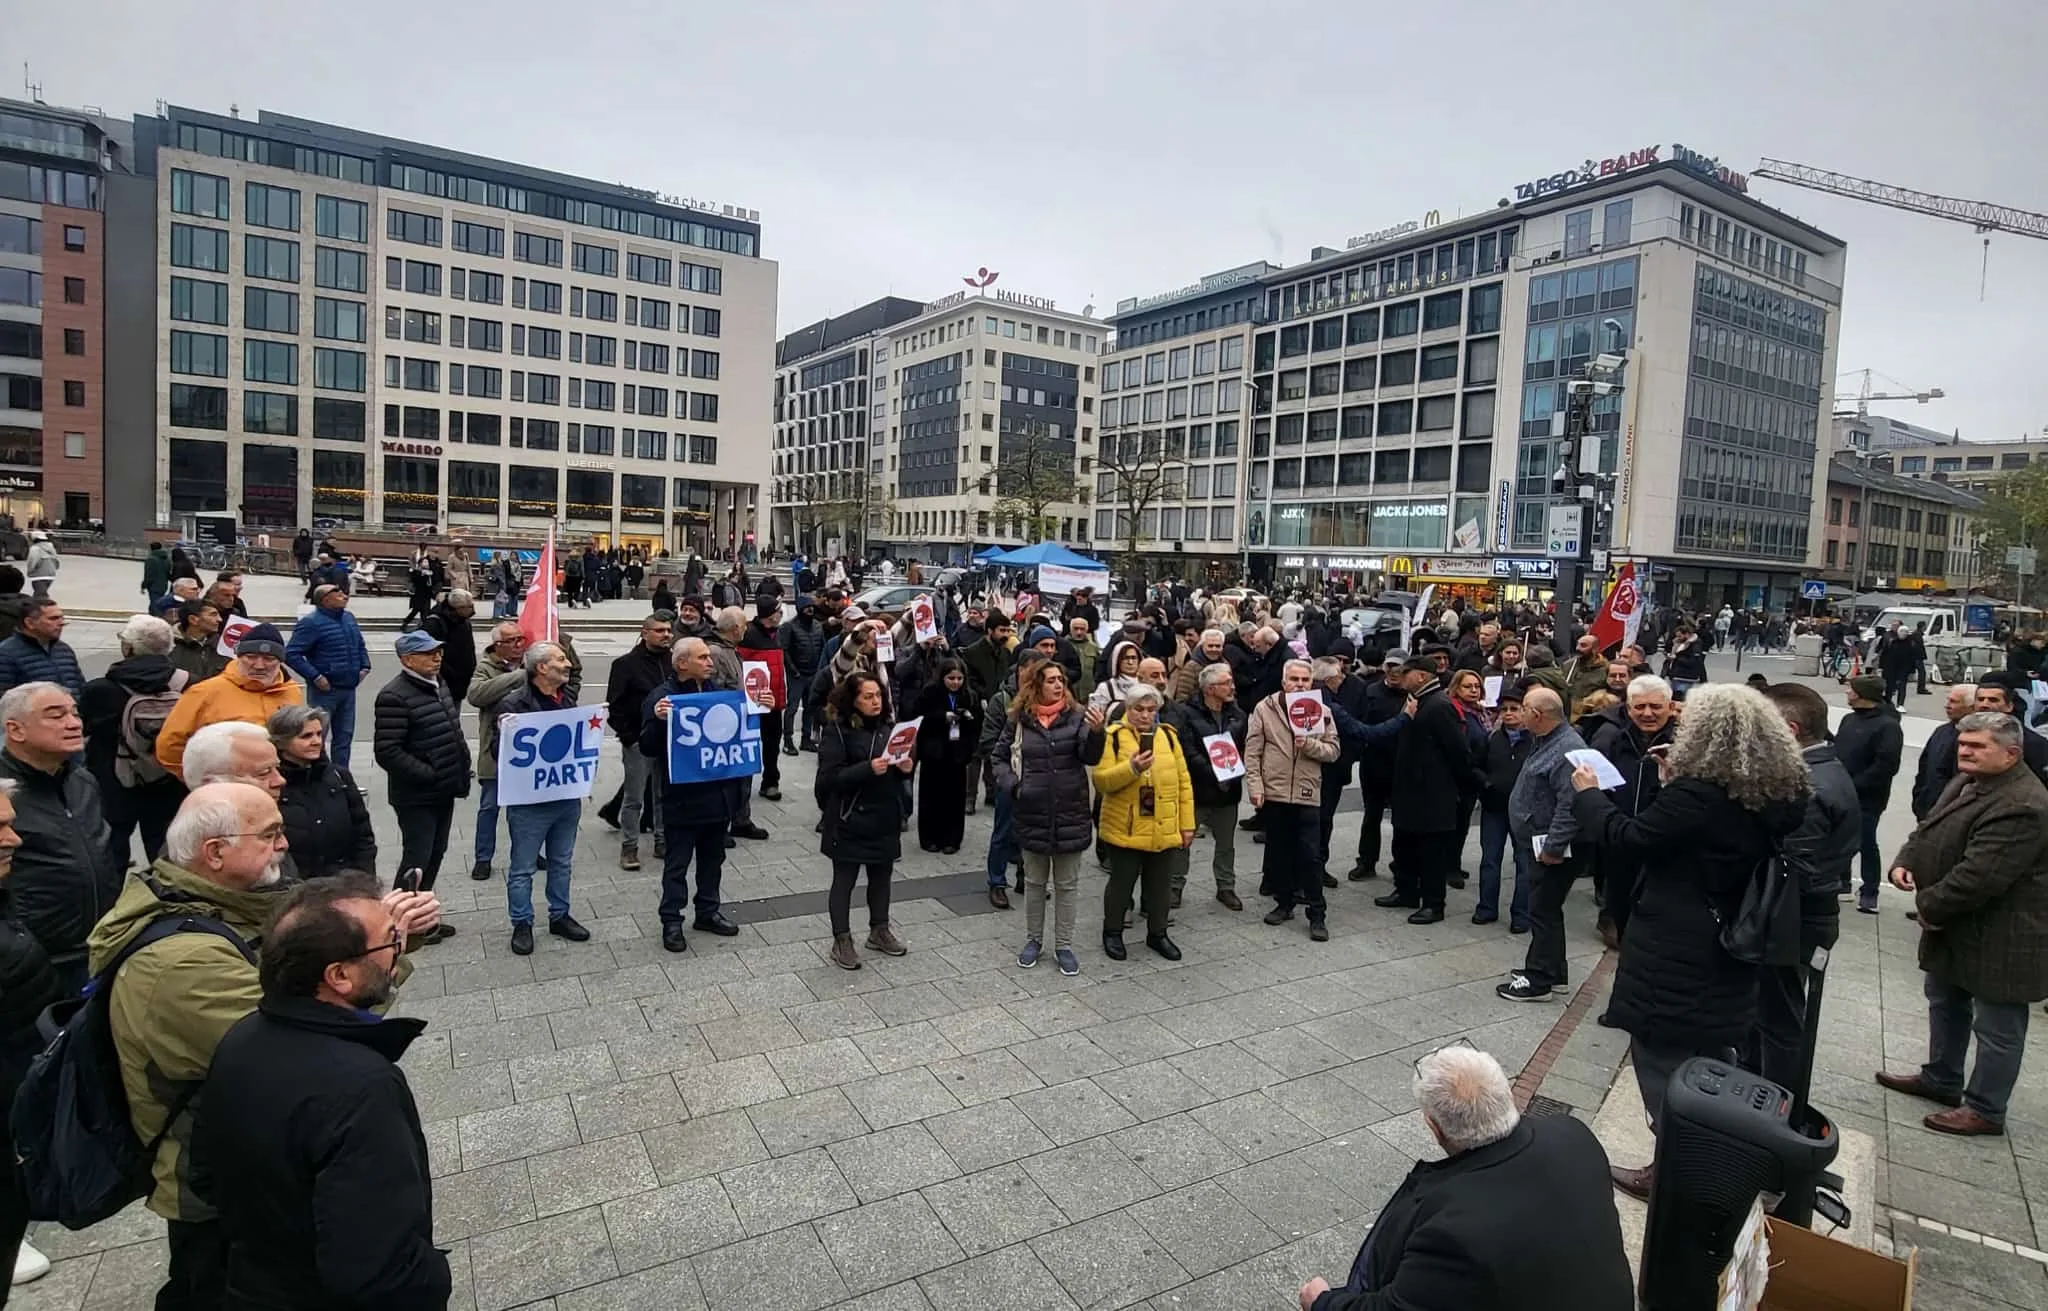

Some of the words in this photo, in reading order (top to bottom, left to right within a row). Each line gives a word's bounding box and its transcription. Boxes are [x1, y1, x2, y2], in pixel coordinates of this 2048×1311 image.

[1514, 169, 1577, 200] TARGO
[1600, 144, 1661, 177] BANK
[996, 288, 1057, 311] HALLESCHE
[380, 440, 443, 455] MAREDO
[1625, 424, 1633, 456] BANK
[1622, 468, 1631, 505] TARGO
[1373, 504, 1448, 518] JACK&JONES
[1328, 557, 1382, 570] JACK&JONES
[676, 702, 761, 747] SOL
[509, 720, 599, 768] SOL
[701, 740, 761, 769] PART
